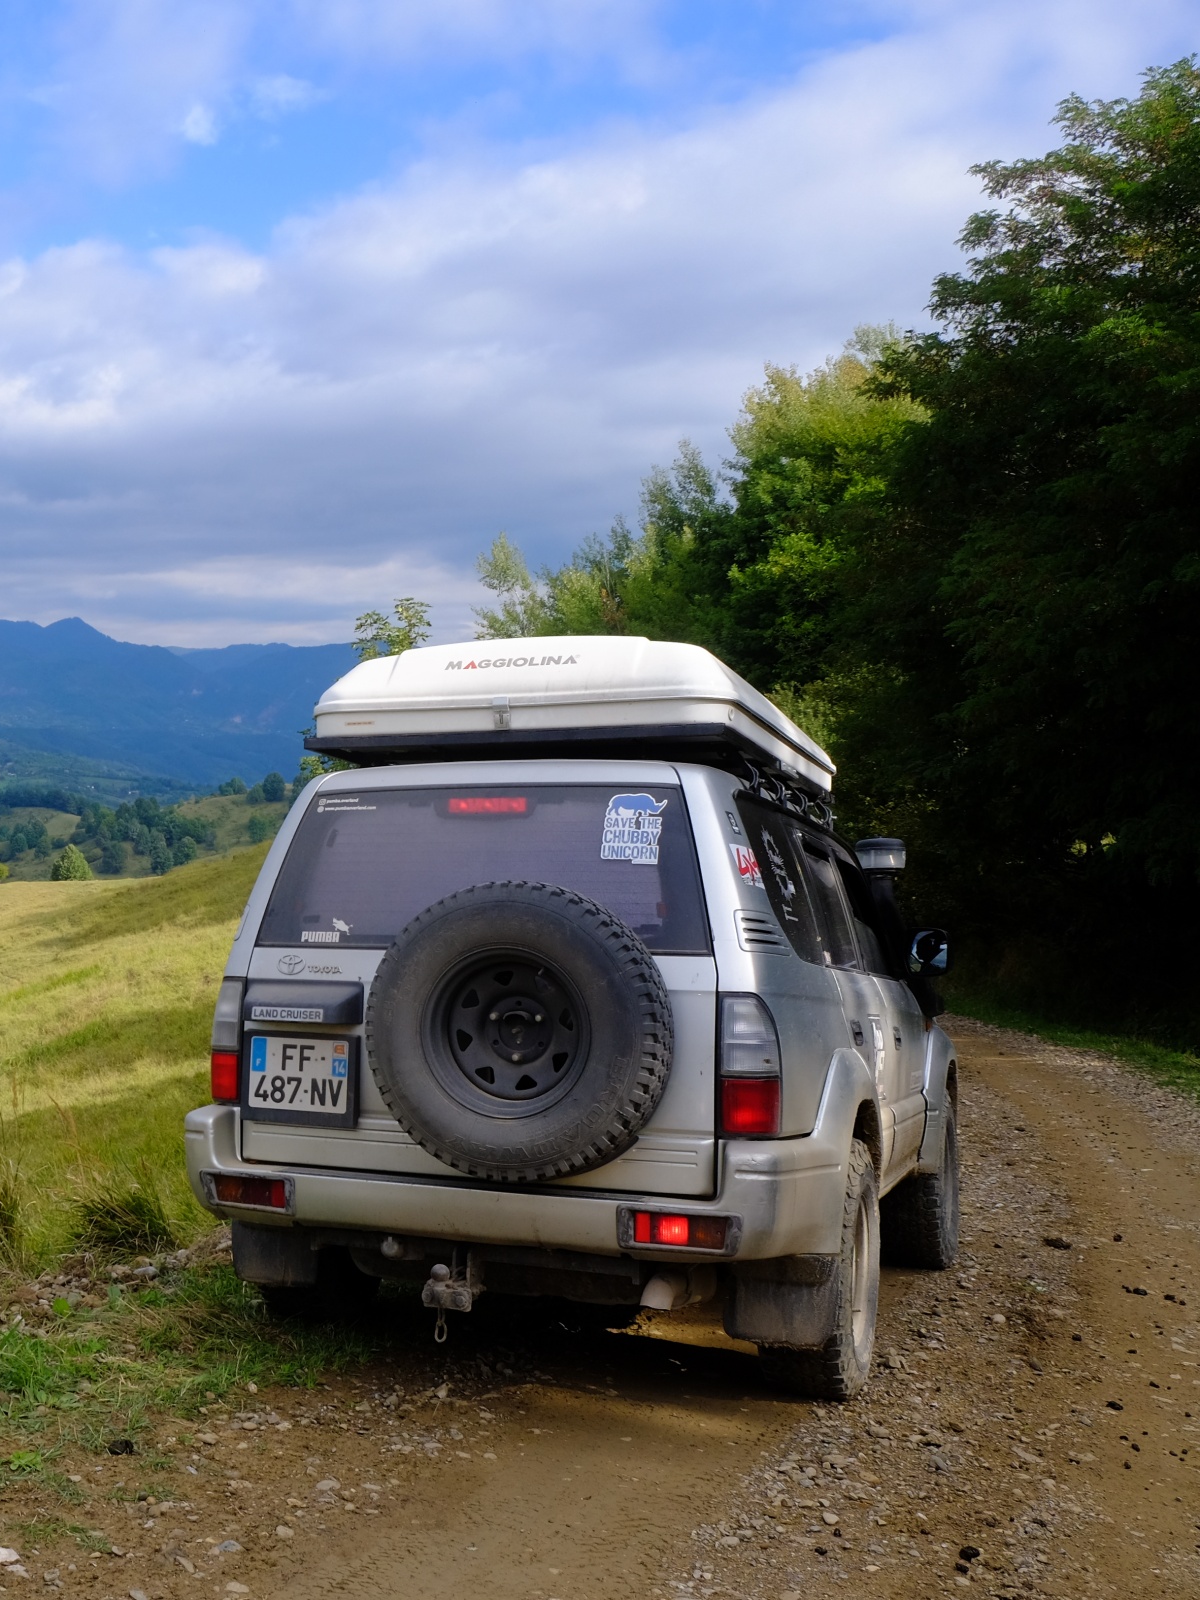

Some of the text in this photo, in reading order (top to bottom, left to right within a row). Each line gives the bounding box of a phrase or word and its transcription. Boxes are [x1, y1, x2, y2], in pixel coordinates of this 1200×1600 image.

[445, 655, 577, 670] MAGGIOLINA
[605, 817, 661, 829] SAVE THE
[603, 829, 660, 845] CHUBBY
[601, 845, 658, 860] UNICORN
[301, 931, 340, 943] PUMBA
[307, 965, 343, 974] TOYOTA
[253, 1009, 321, 1020] LAND CRUISER
[333, 1061, 346, 1075] 14
[254, 1075, 343, 1107] 487-NV
